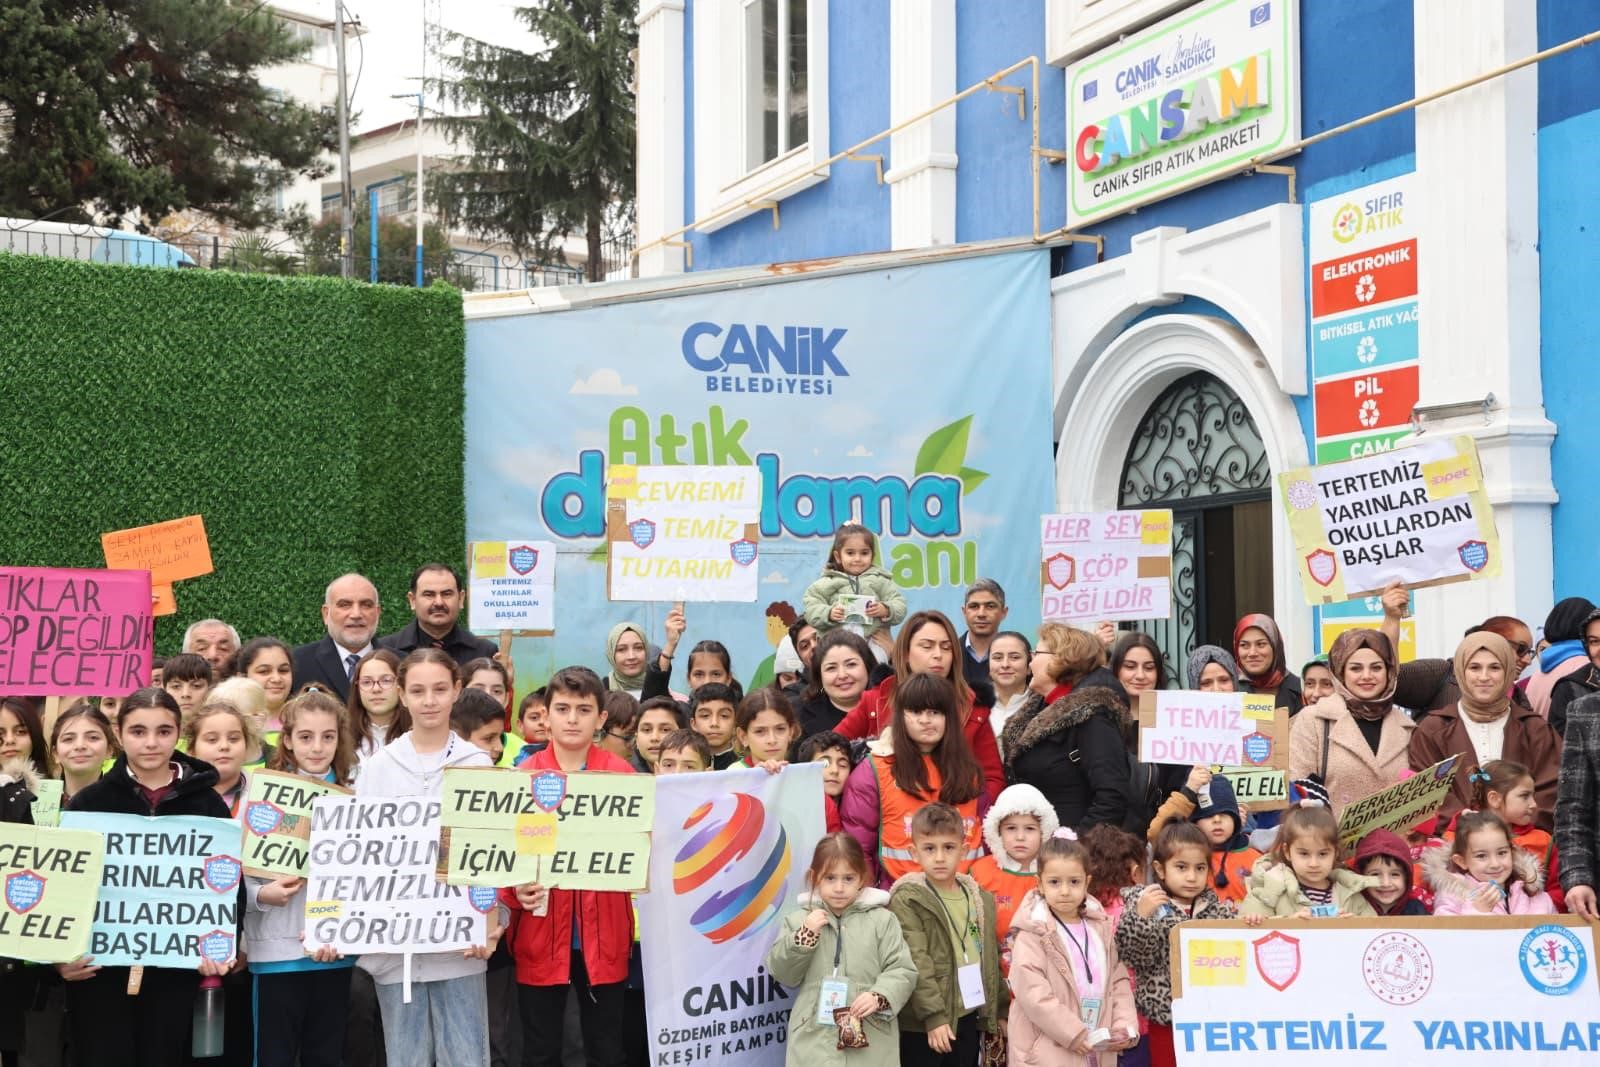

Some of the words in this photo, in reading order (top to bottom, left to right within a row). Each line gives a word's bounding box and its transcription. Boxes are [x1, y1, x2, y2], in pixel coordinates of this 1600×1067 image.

[1075, 54, 1260, 173] CANSAM
[1132, 160, 1163, 184] SIFIR
[1166, 150, 1195, 171] ATIK
[1199, 119, 1260, 160] MARKETİ
[1365, 191, 1403, 216] SIFIR
[1366, 208, 1403, 234] ATIK
[1368, 314, 1393, 331] ATIK
[609, 405, 753, 465] Atık
[1350, 438, 1391, 459] CAM
[636, 476, 746, 507] ÇEVREMİ
[1318, 461, 1424, 498] TERTEMİZ
[1326, 487, 1429, 523] YARINLAR
[664, 514, 739, 540] TEMİZ
[1044, 519, 1090, 539] HER
[1104, 515, 1142, 538] ŞEY
[1328, 503, 1472, 546] OKULLARDAN
[1343, 538, 1424, 566] BAŞLAR
[621, 557, 734, 579] TUTARIM
[1082, 553, 1128, 580] ÇÖP
[496, 611, 528, 619] BAŞLAR
[1165, 705, 1241, 730] TEMİZ
[1151, 736, 1239, 764] DÜNYA
[1236, 777, 1252, 796] EL
[454, 787, 535, 814] TEMİZ
[557, 794, 643, 821] ÇEVRE
[103, 829, 213, 856] RTEMİZ
[252, 835, 309, 870] İÇİN
[459, 843, 516, 876] İÇİN
[551, 851, 579, 874] EL
[588, 852, 635, 874] ELE
[102, 865, 205, 889] RINLAR
[20, 913, 75, 940] ELE
[314, 911, 474, 945] GÖRÜLÜR
[91, 932, 201, 960] BAŞLAR
[683, 966, 789, 1017] CANİK
[658, 1020, 726, 1045] ÖZDEMİR
[730, 1008, 792, 1034] BAYRAKT
[1175, 1013, 1387, 1052] TERTEMİZ
[658, 1043, 712, 1066] KEŞİF
[721, 1026, 786, 1055] KAMPÜ
